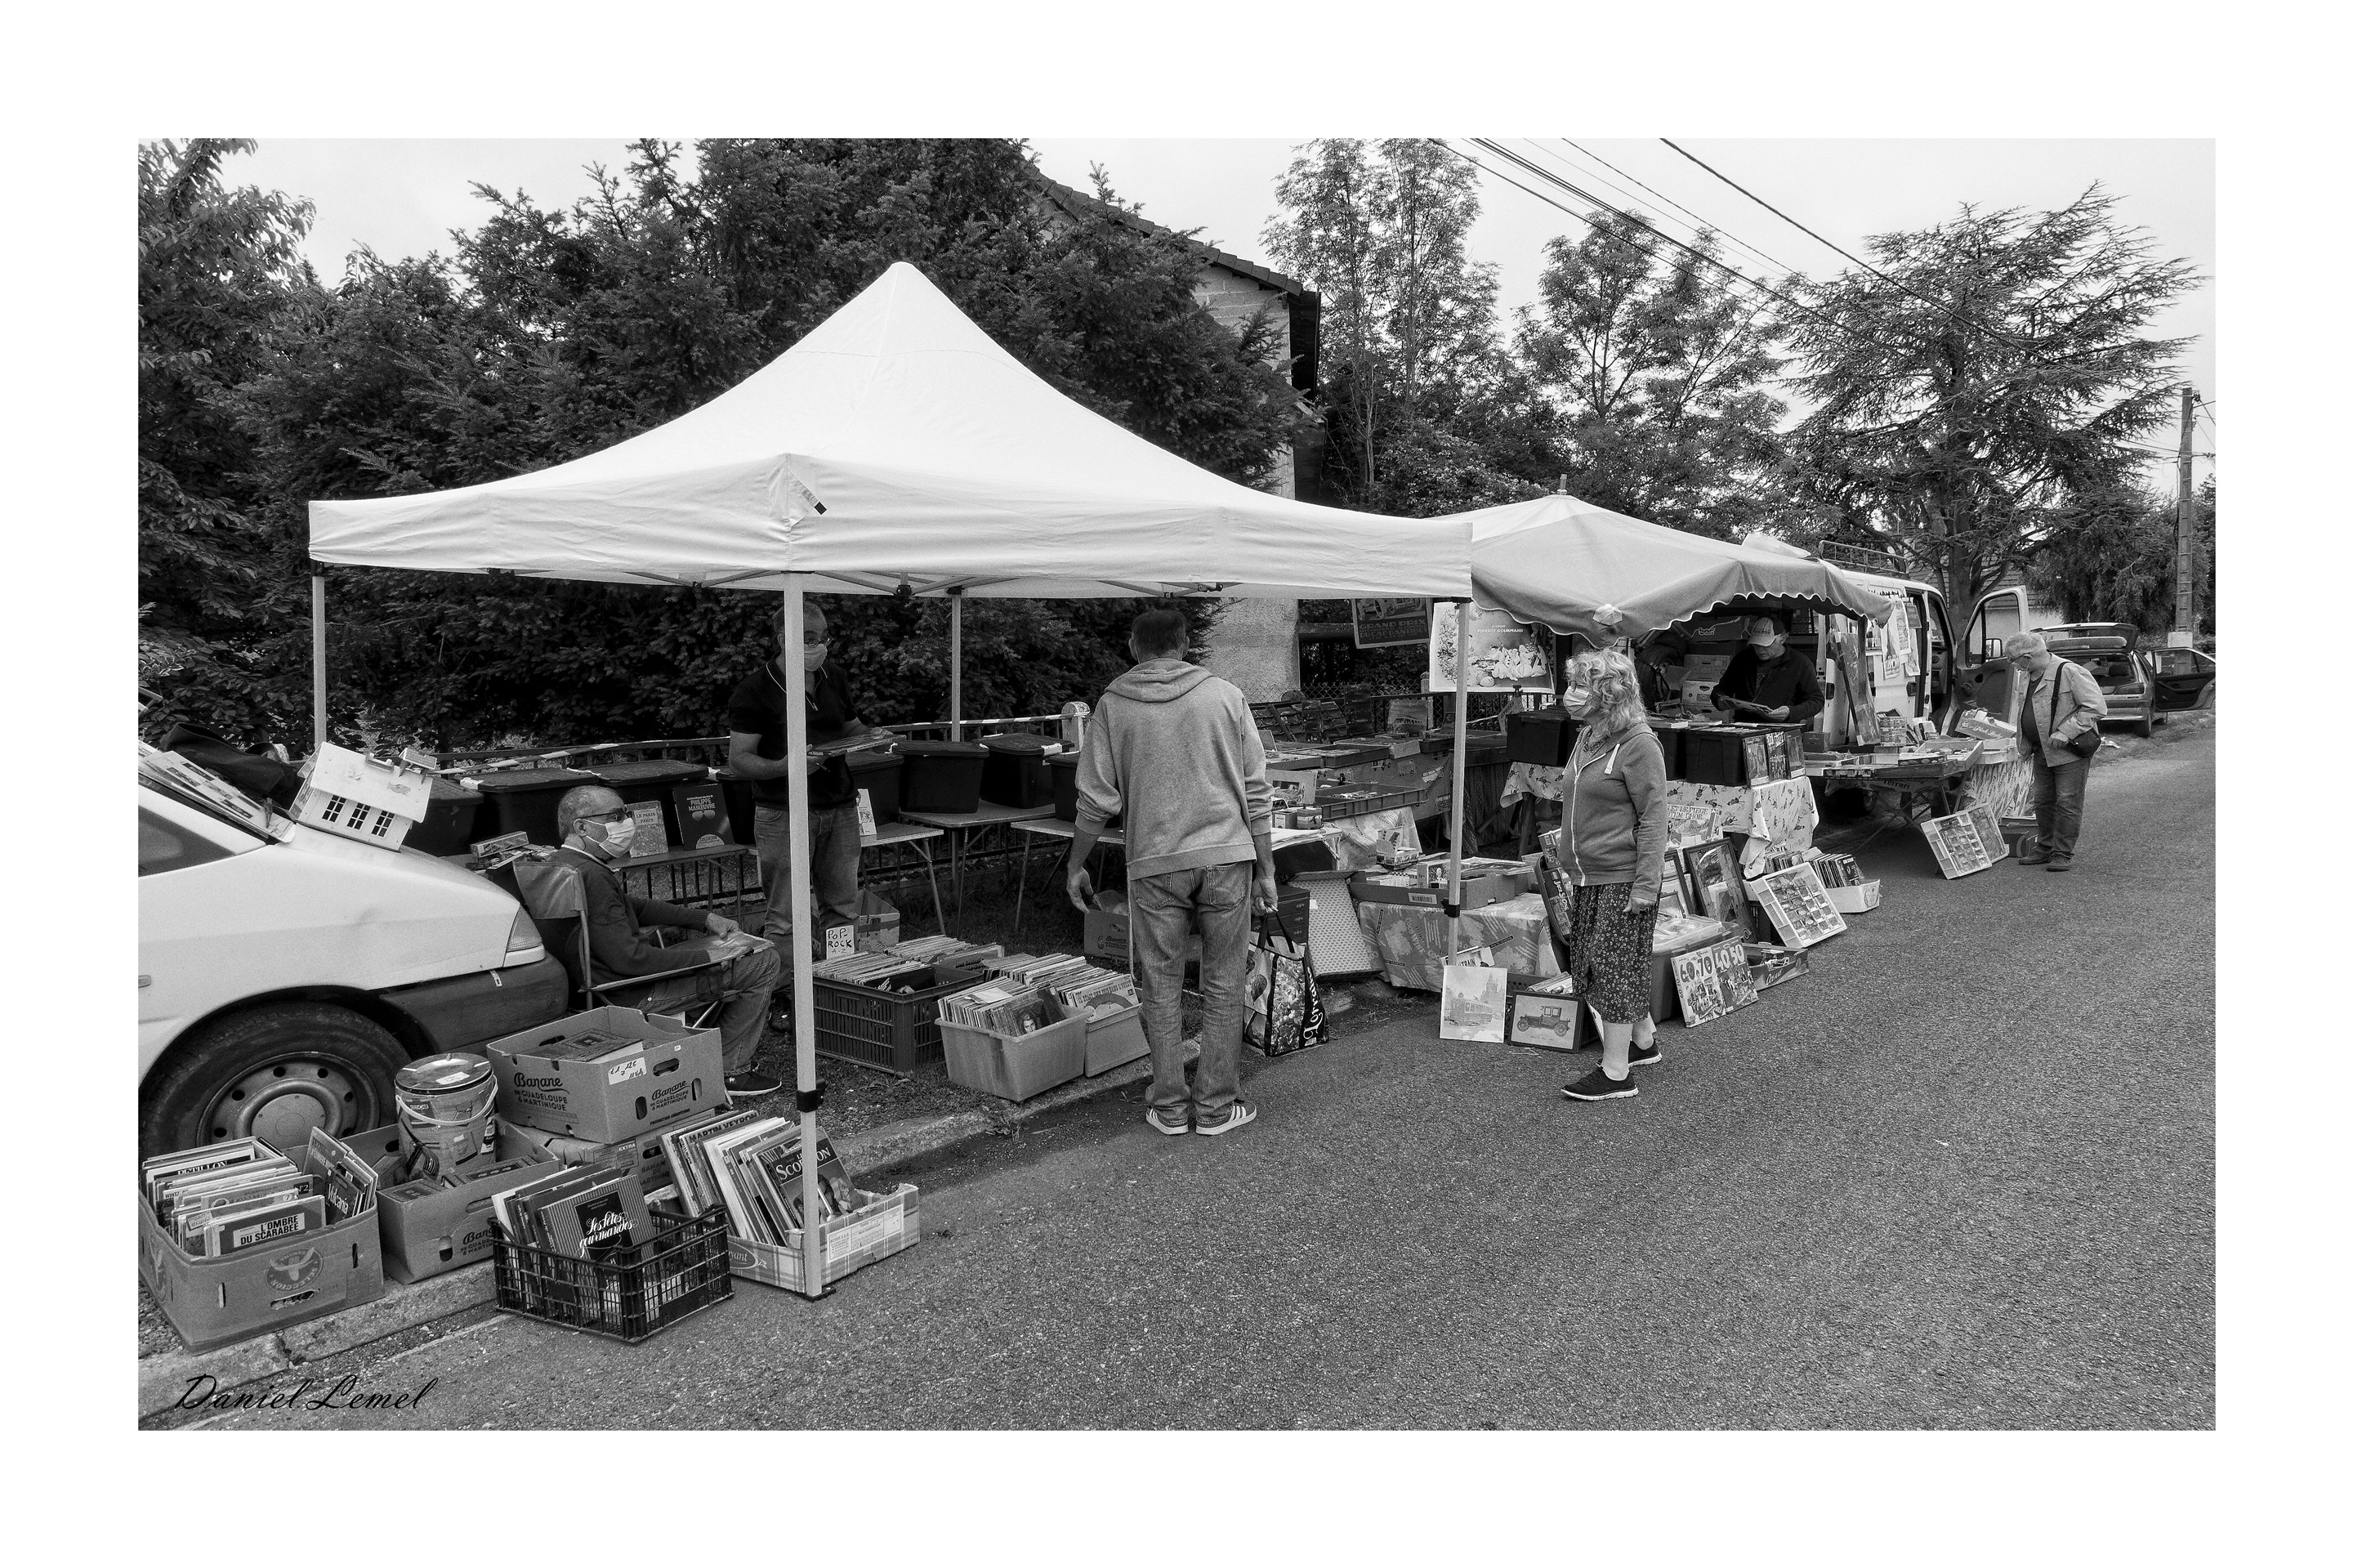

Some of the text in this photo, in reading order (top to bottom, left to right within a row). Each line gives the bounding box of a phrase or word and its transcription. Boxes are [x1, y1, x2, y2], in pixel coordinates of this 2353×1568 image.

[1360, 619, 1427, 630] GRAND PRIX
[828, 940, 852, 948] ROCK
[514, 1072, 566, 1092] Banane
[521, 1090, 568, 1104] GUADELOUPE
[651, 1080, 689, 1101] Banane
[656, 1090, 689, 1104] GUADELOUPE
[524, 1098, 567, 1110] MARTINIQUE
[656, 1096, 687, 1110] MARTINIQUE
[618, 1143, 636, 1151] EXTRA
[261, 1215, 299, 1231] L'OMBRE
[586, 1216, 604, 1235] Les
[240, 1235, 253, 1245] DU
[462, 1226, 492, 1244] Ban
[578, 1217, 640, 1258] gourmandes
